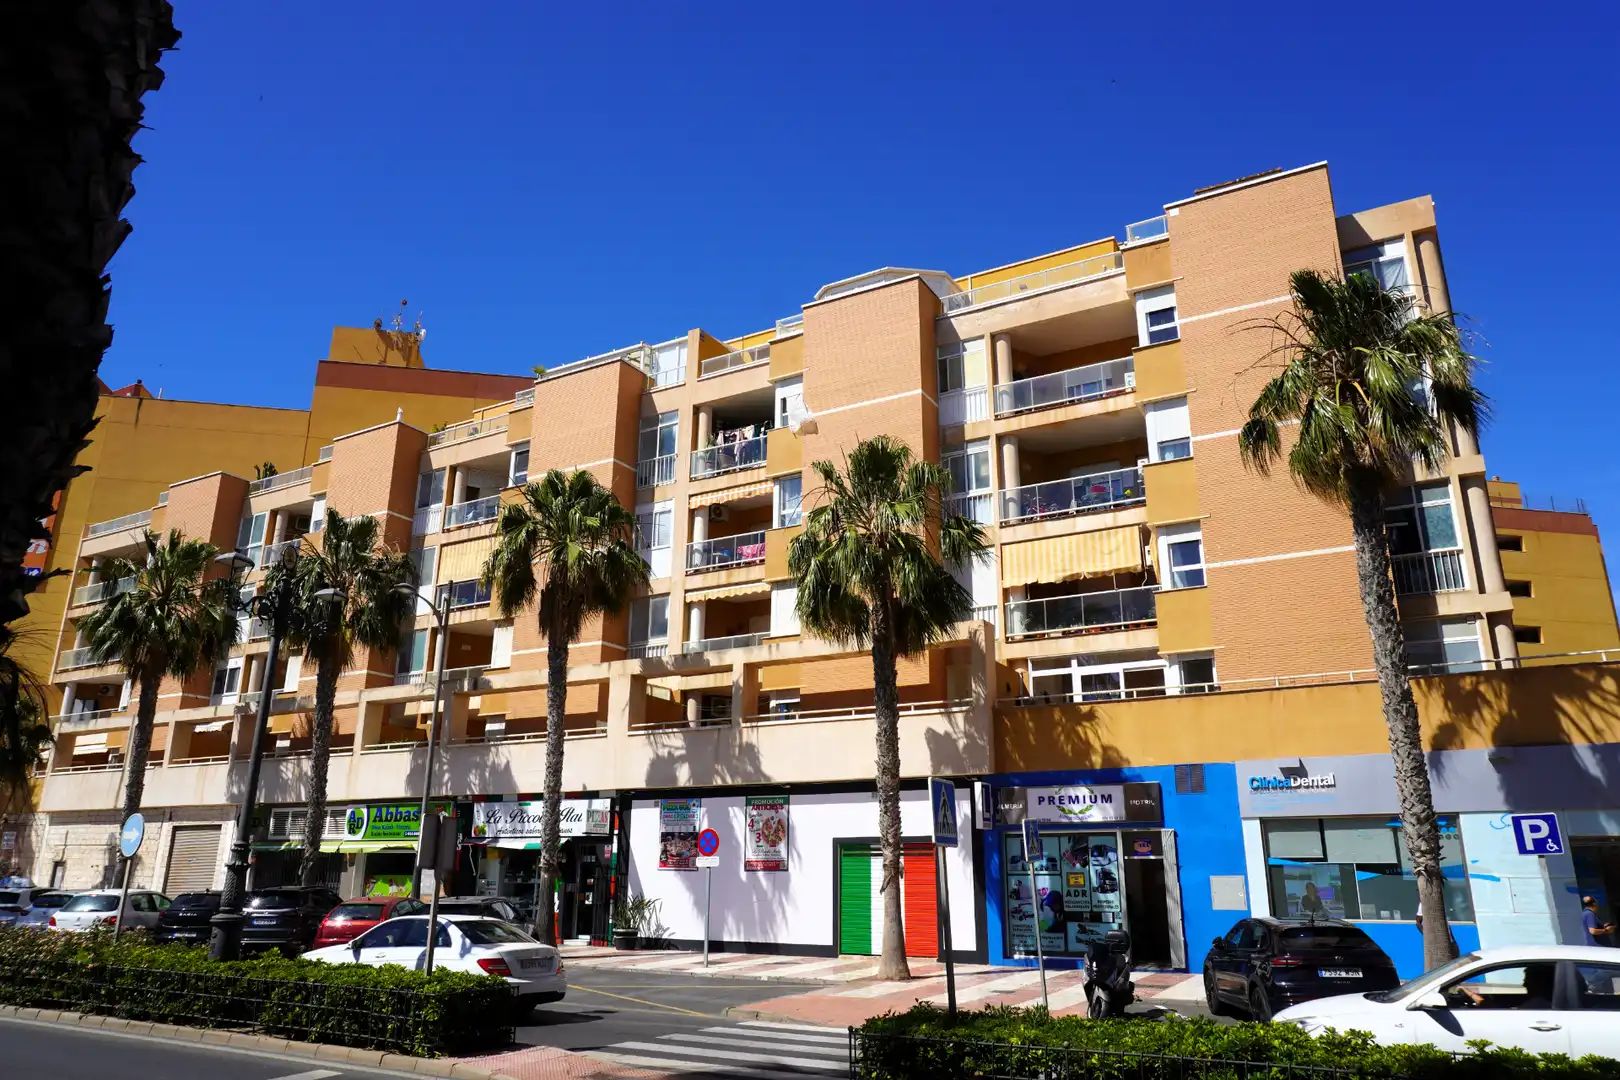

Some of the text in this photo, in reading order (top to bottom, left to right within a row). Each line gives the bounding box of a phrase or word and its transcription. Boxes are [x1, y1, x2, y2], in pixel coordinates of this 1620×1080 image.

[1038, 793, 1113, 806] PREMIUM
[373, 806, 420, 823] Abbas
[482, 808, 502, 824] La
[506, 808, 542, 824] Picco
[748, 818, 754, 829] 4
[755, 832, 761, 843] 3
[1520, 818, 1549, 850] P
[1066, 889, 1088, 898] ADR
